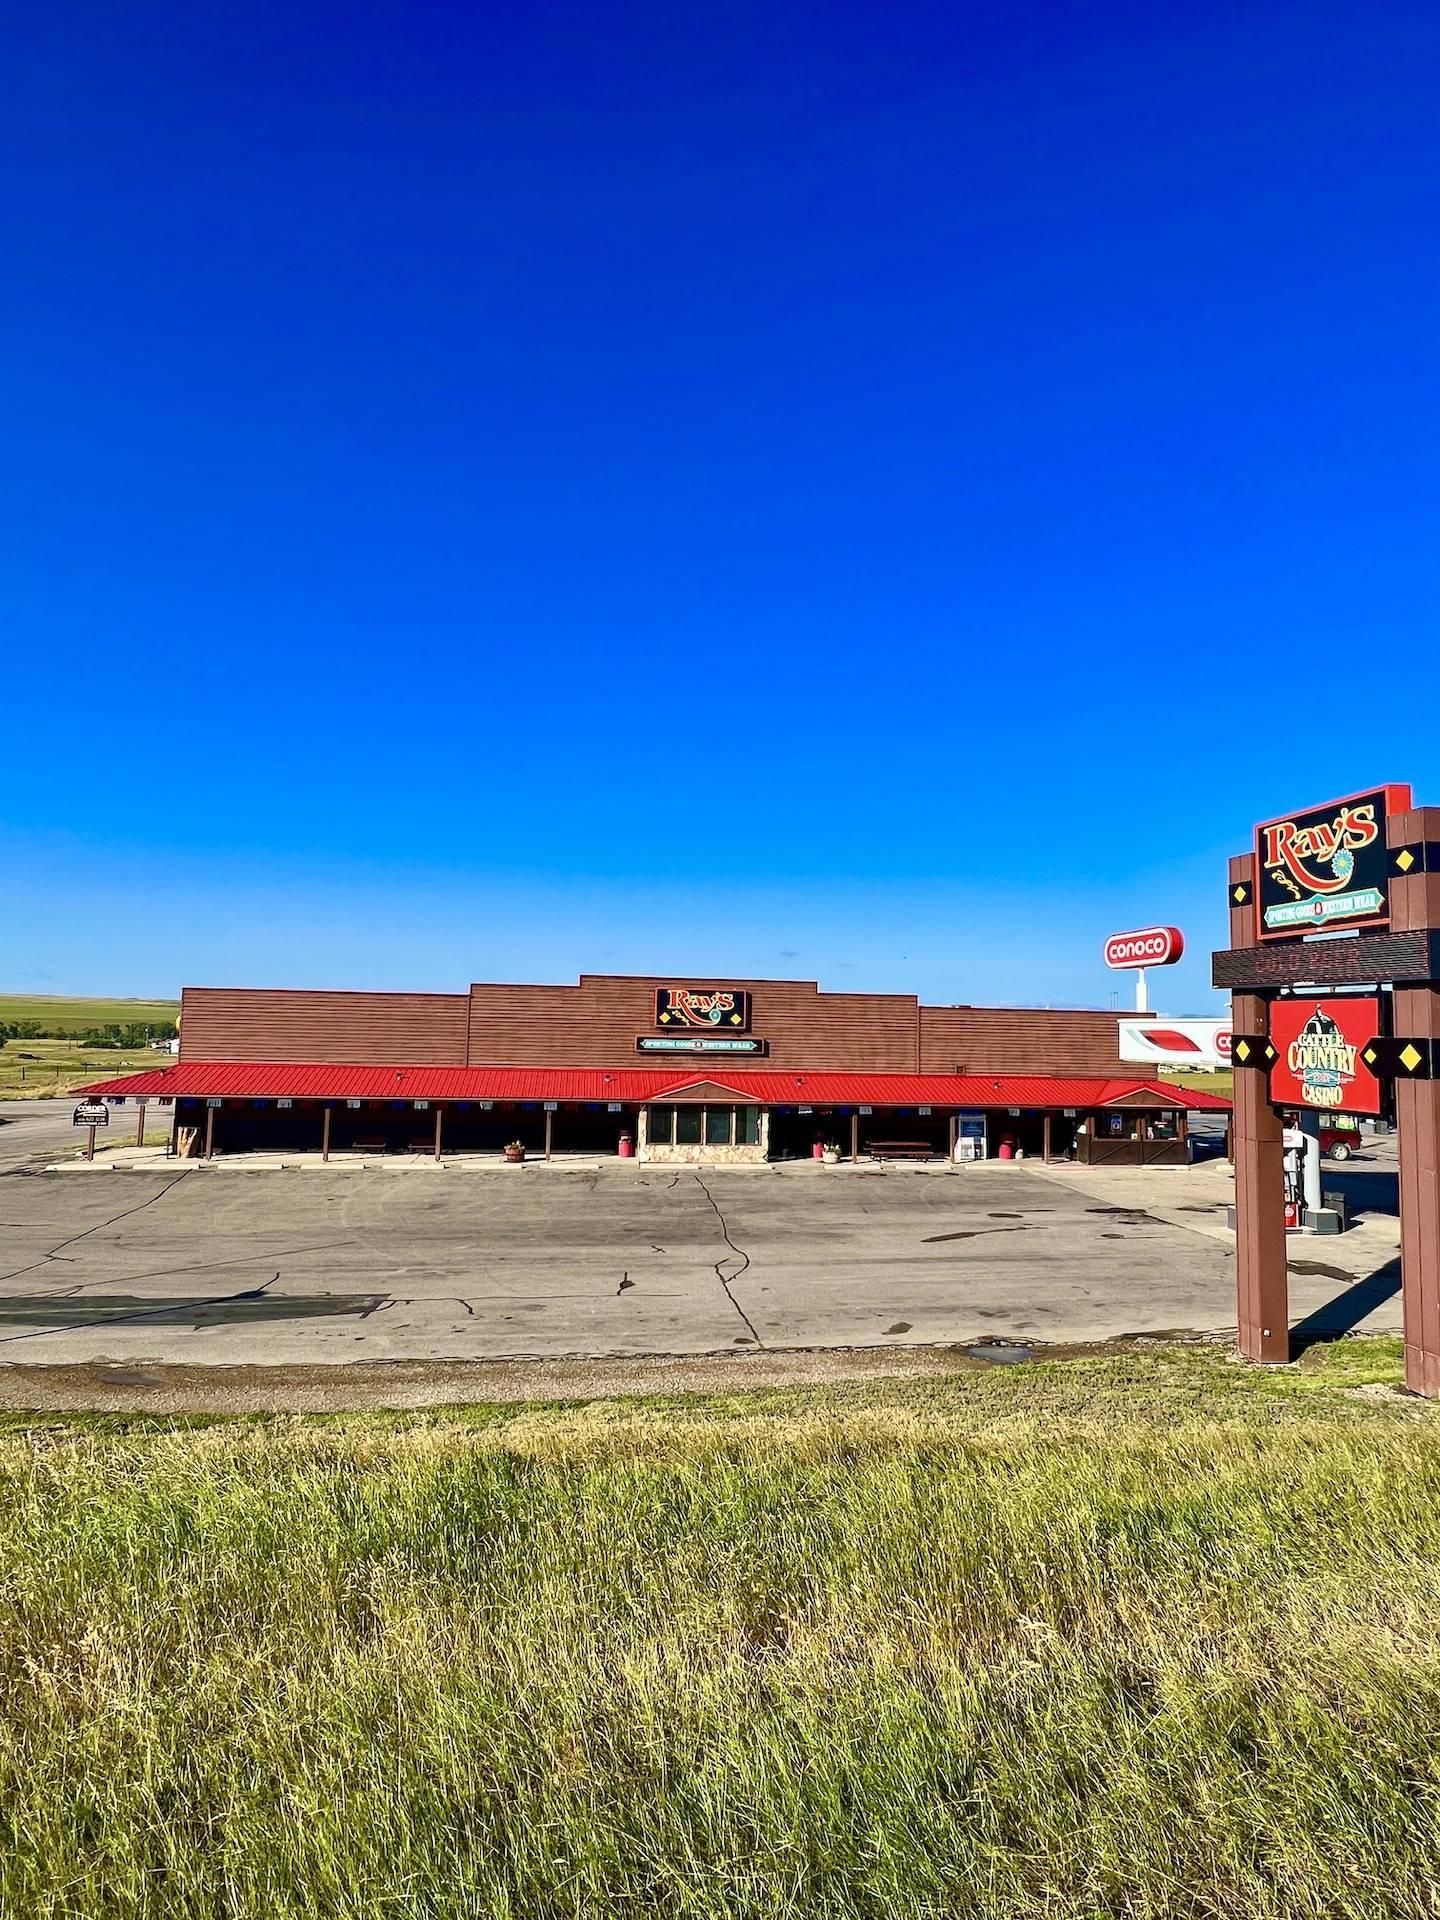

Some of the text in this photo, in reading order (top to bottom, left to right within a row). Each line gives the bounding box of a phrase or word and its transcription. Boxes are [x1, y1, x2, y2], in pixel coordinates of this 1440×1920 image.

[1297, 1033, 1345, 1049] CATTLE
[1288, 1041, 1358, 1077] COUNTRY
[1302, 1083, 1343, 1106] CASINO
